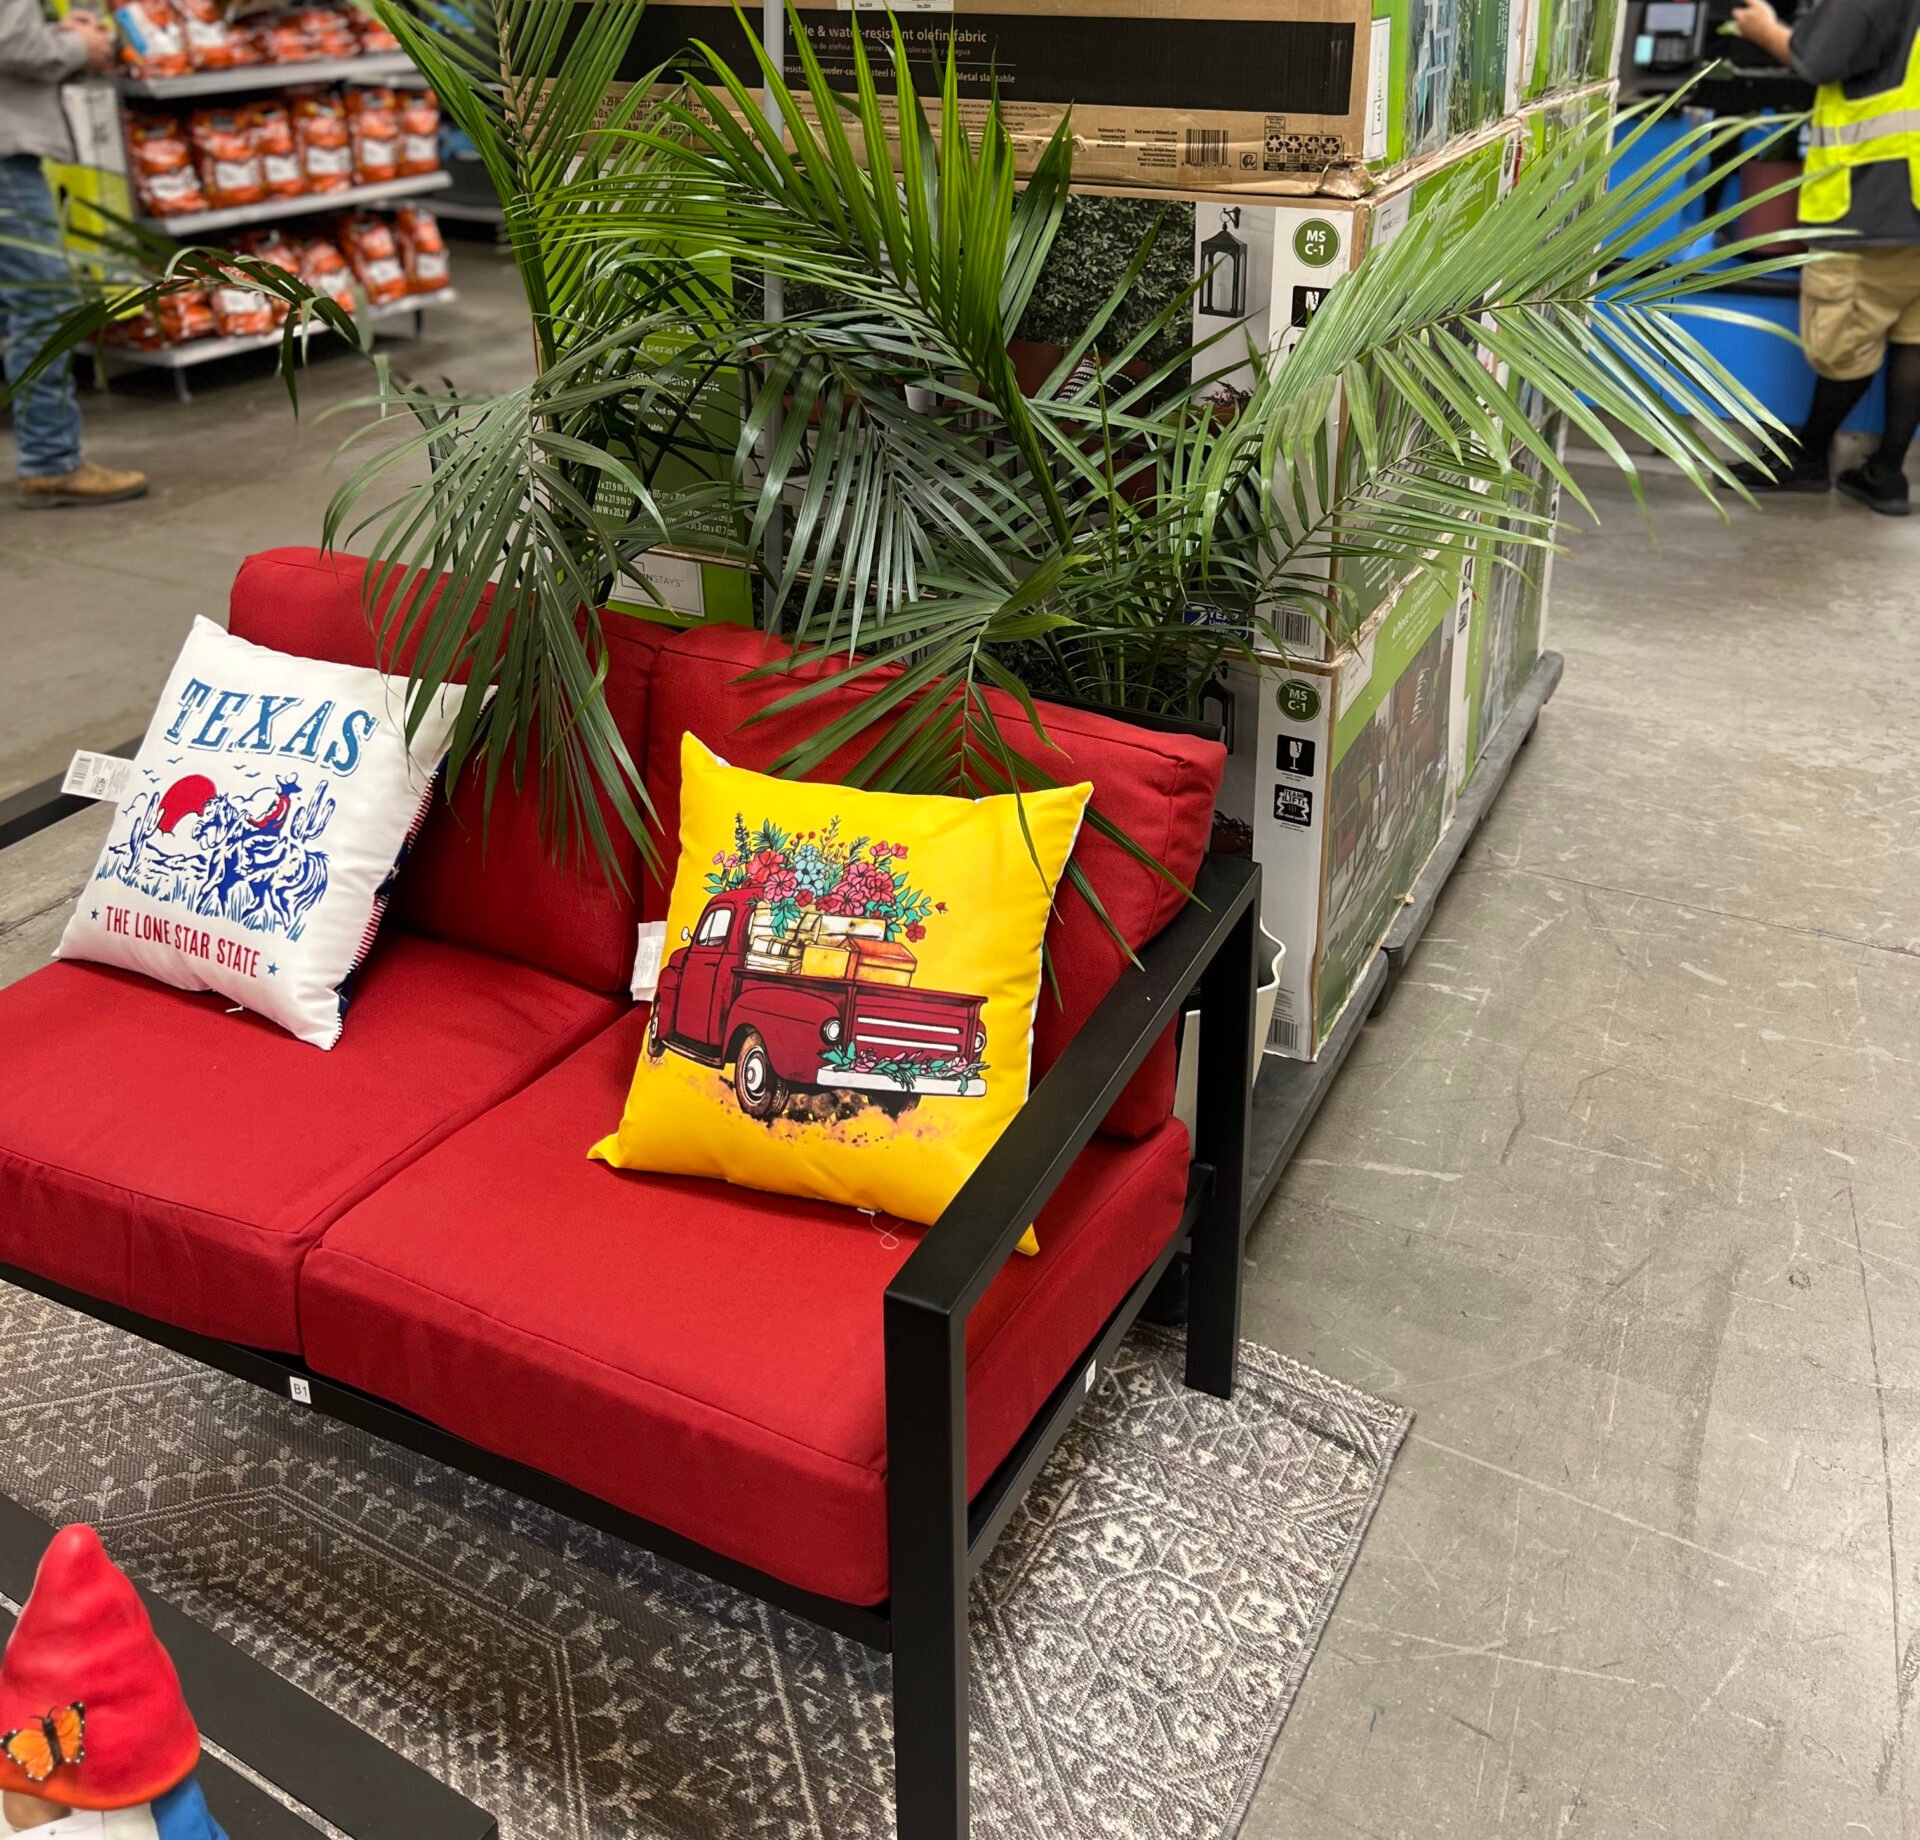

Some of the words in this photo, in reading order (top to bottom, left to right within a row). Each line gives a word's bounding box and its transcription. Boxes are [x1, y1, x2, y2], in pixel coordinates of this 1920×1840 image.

[788, 25, 814, 36] Fde
[818, 25, 826, 36] &
[954, 29, 987, 42] fabric
[957, 72, 978, 81] Metal
[1306, 229, 1326, 242] MS
[1304, 243, 1324, 256] C-1
[647, 344, 673, 355] piezas
[1289, 688, 1308, 701] MS
[1287, 700, 1306, 712] C-1
[164, 677, 382, 778] TEXAS
[106, 905, 131, 936] THE
[135, 912, 172, 945] LONE
[174, 923, 211, 960] STAR
[216, 937, 261, 978] STATE
[293, 1383, 308, 1397] B1
